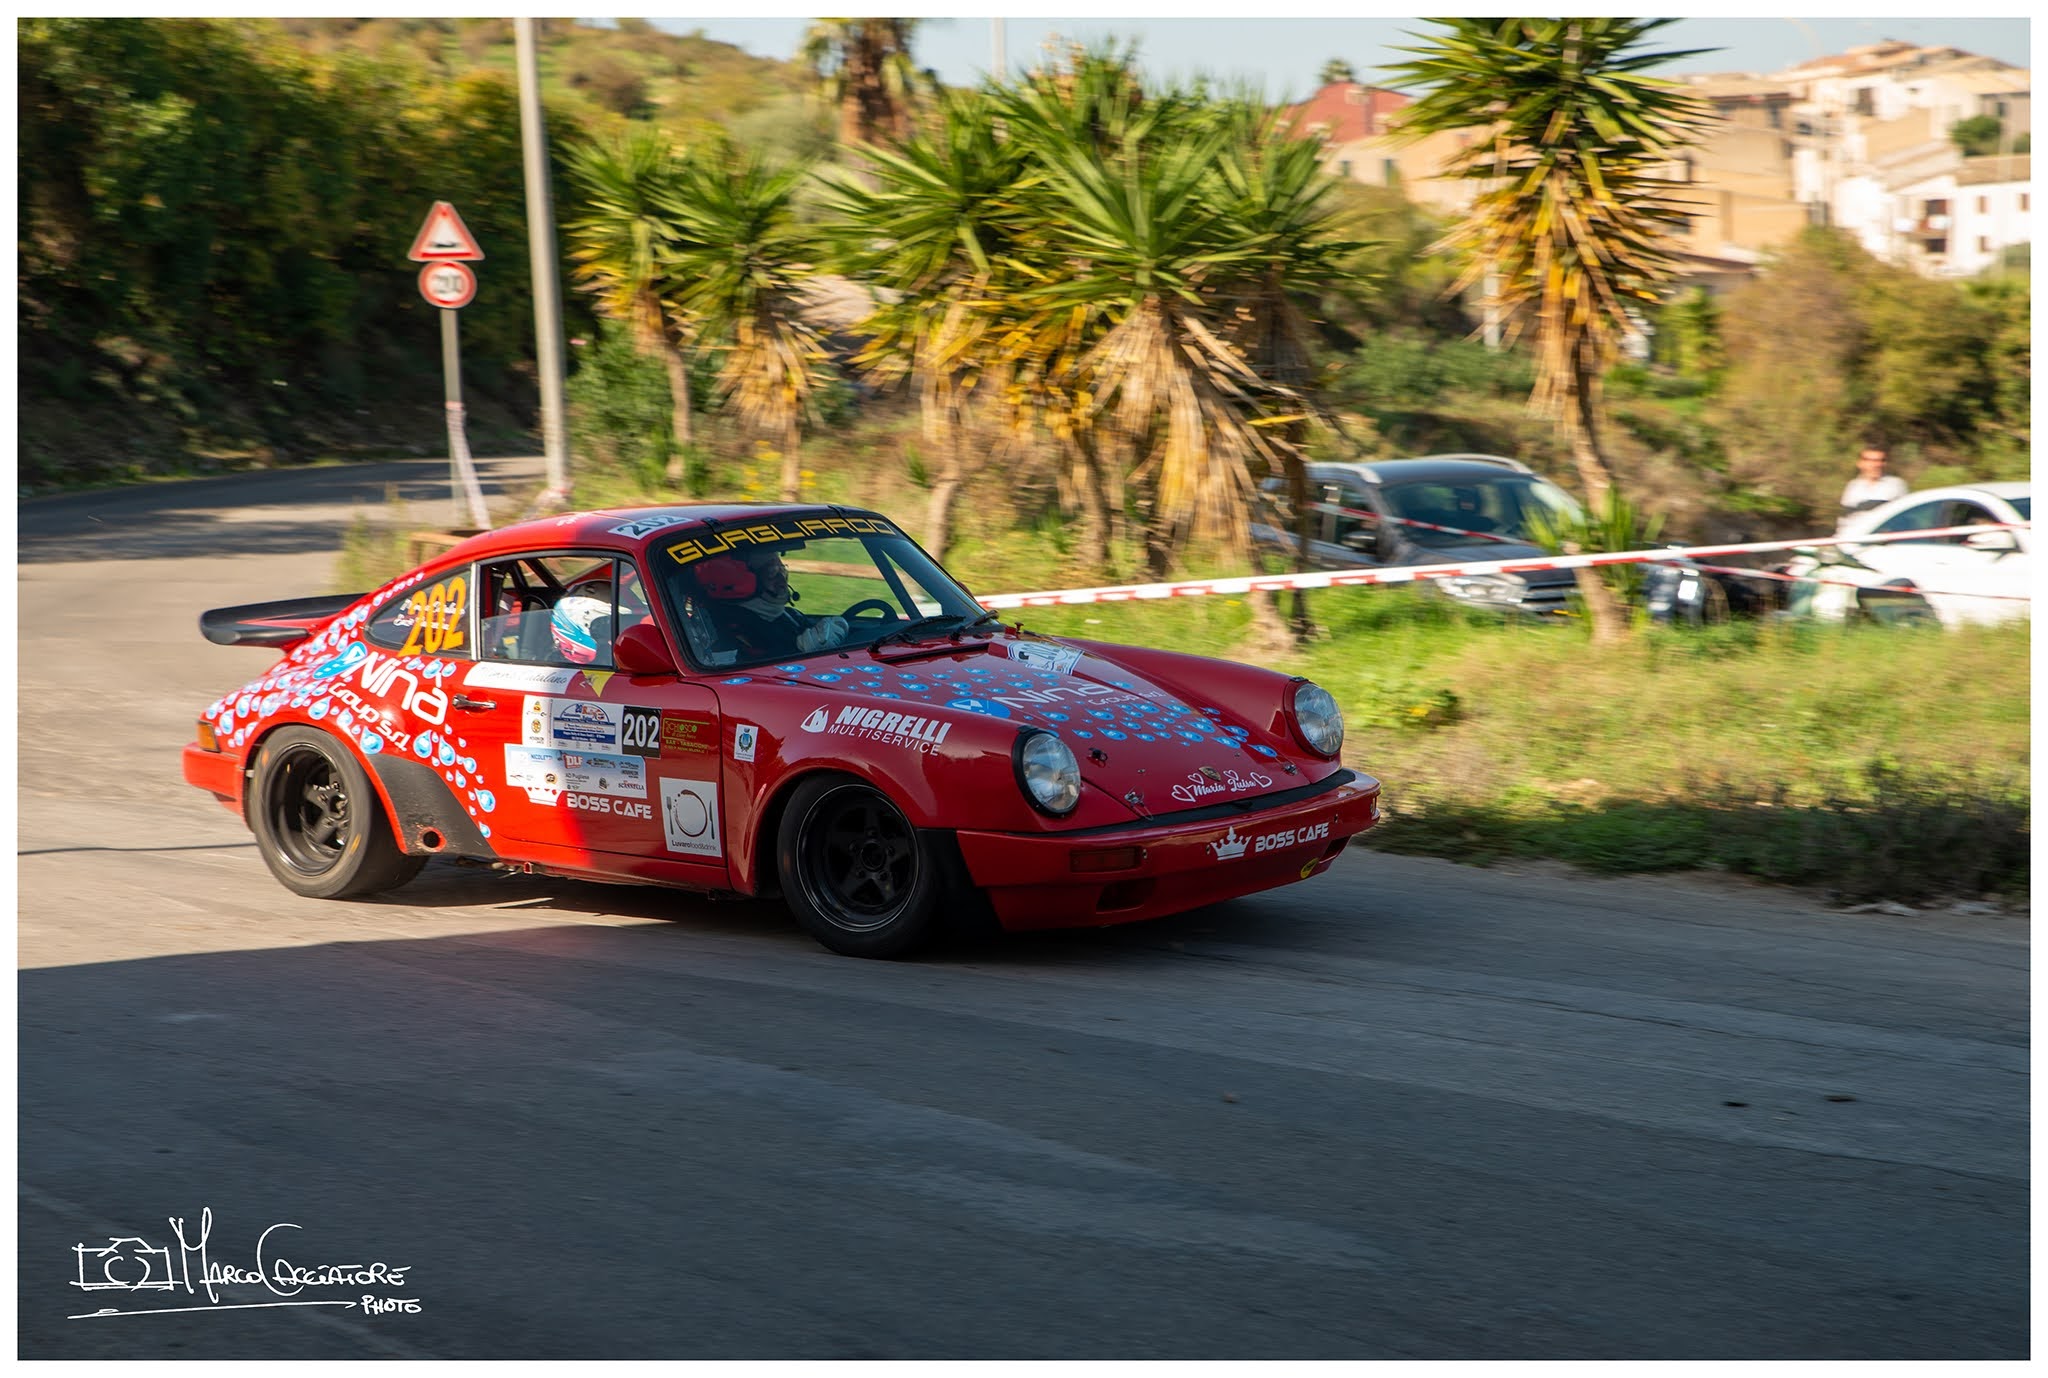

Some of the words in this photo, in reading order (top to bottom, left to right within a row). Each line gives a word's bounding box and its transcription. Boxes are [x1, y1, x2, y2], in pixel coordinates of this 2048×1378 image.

[617, 516, 685, 536] 202
[666, 517, 897, 564] GUAGLIARDO
[396, 576, 467, 657] 202
[328, 682, 380, 723] Group
[622, 713, 660, 749] 202
[827, 724, 942, 757] MULTISERVICE
[834, 705, 953, 745] NIGRELLI
[1187, 782, 1226, 797] Maria
[1227, 778, 1257, 792] Luisa
[566, 792, 611, 813] BOSS
[613, 800, 653, 820] CAFE
[1255, 829, 1296, 853] BOSS
[1297, 822, 1330, 844] CAFE
